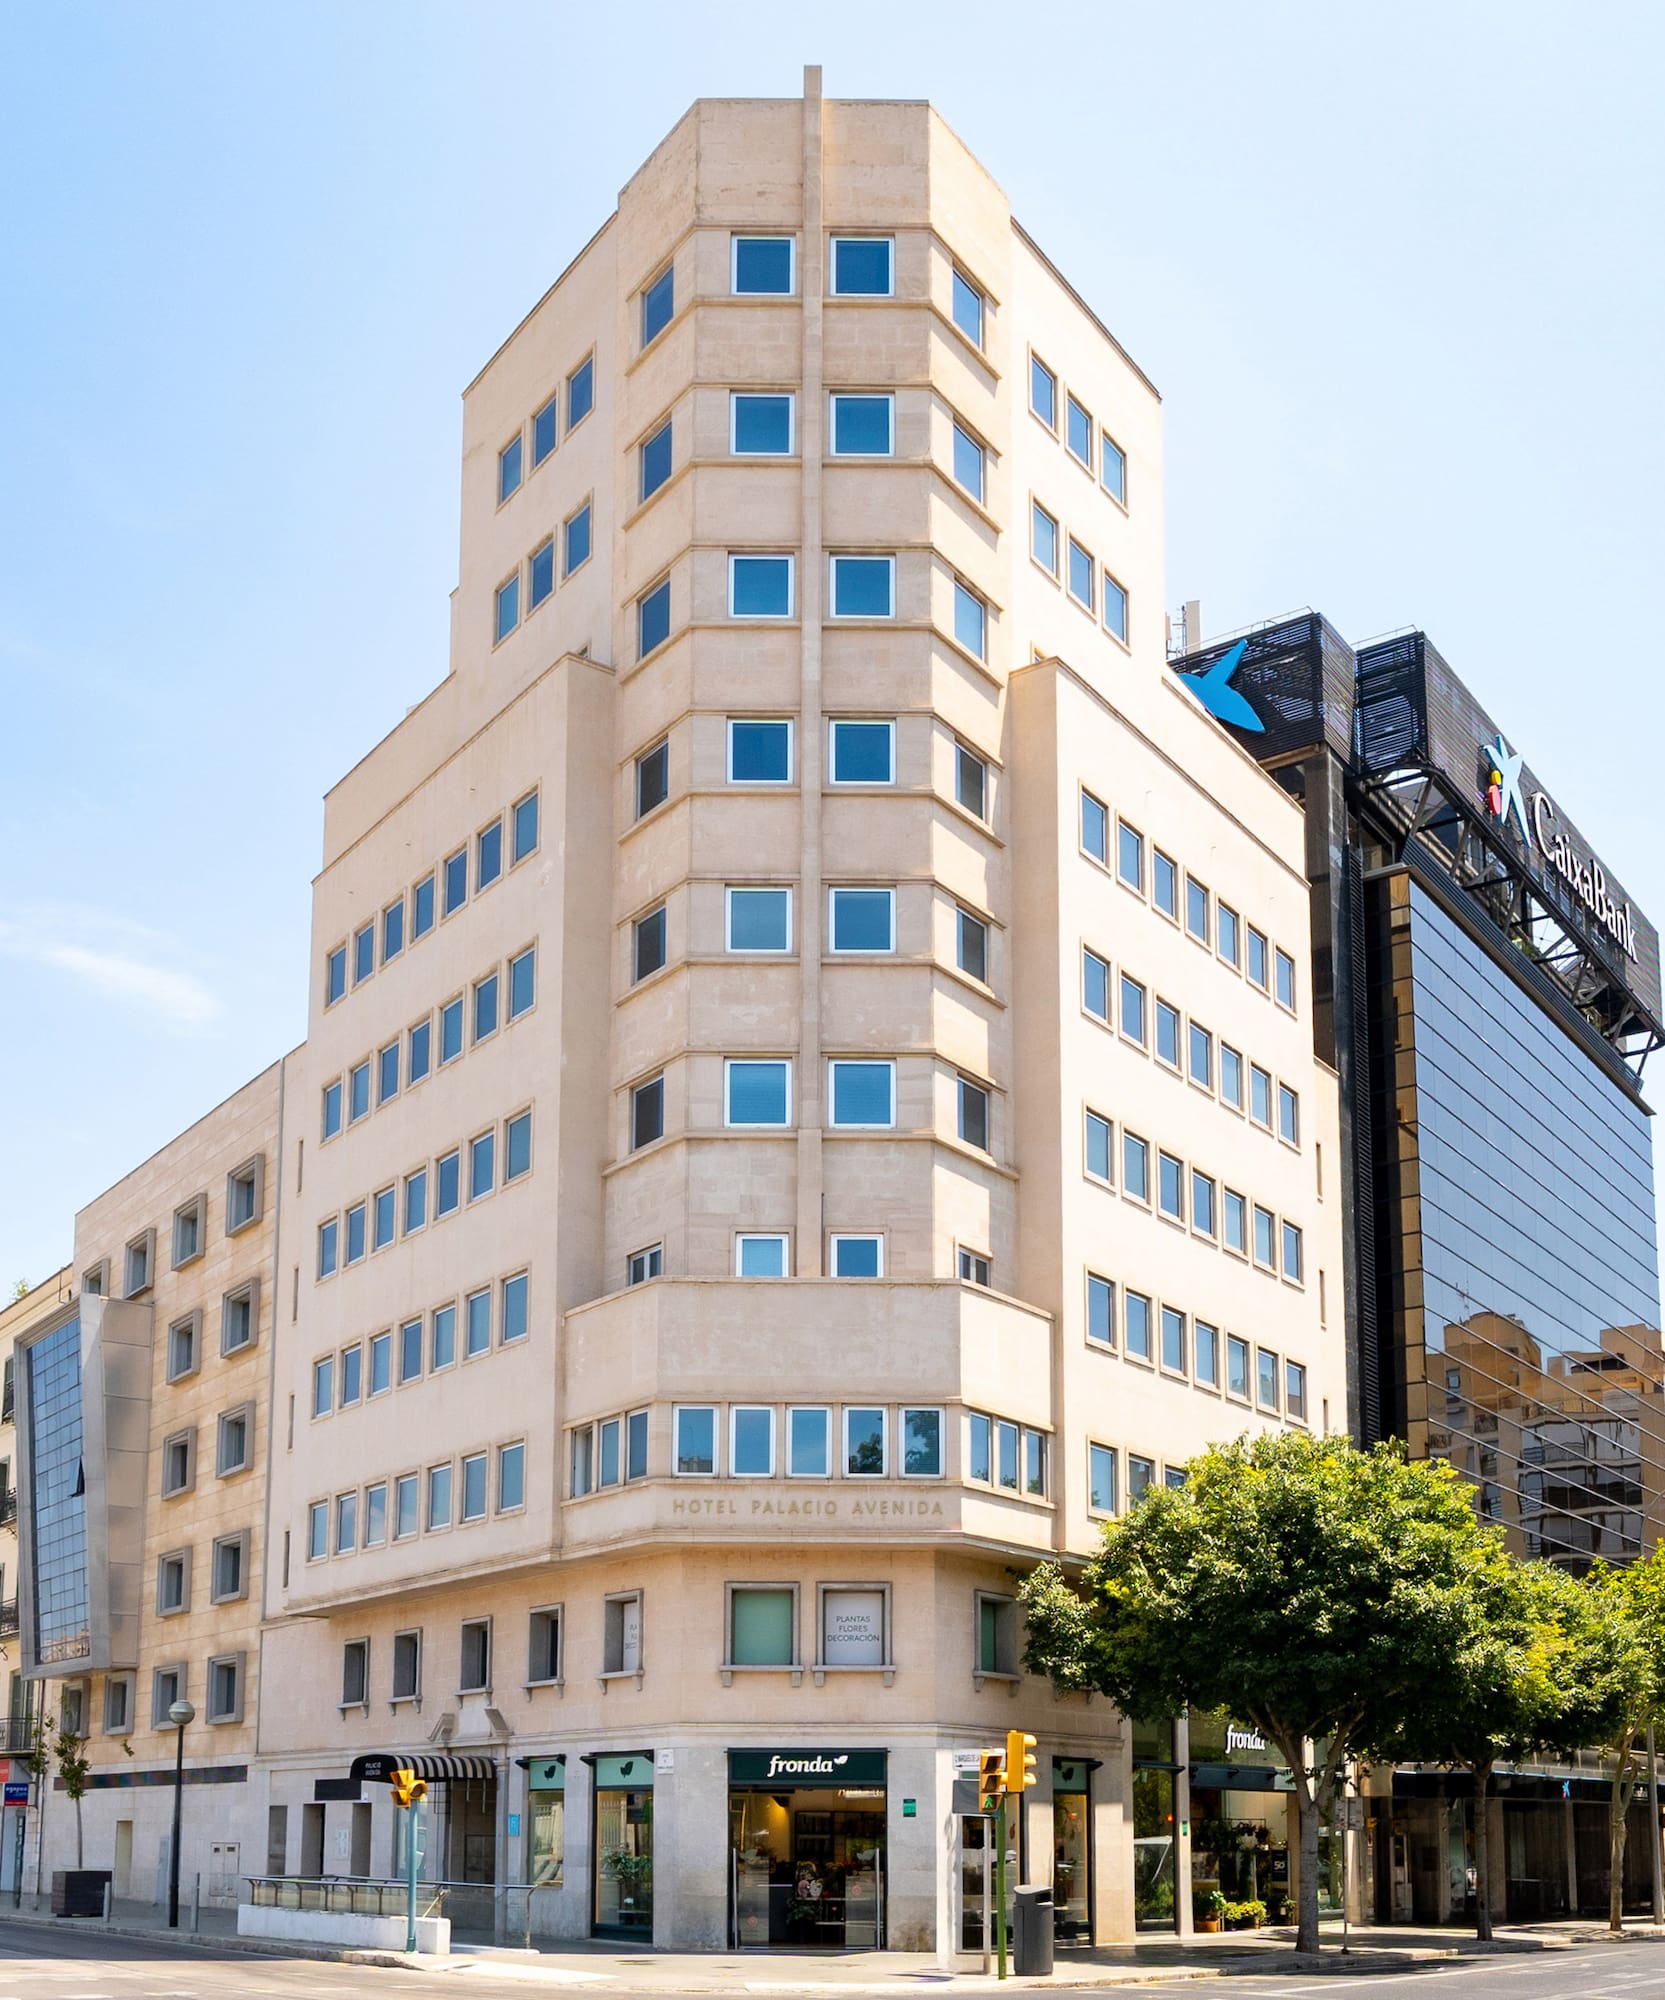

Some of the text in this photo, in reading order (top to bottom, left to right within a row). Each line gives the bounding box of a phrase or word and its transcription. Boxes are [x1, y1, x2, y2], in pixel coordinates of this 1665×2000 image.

[1531, 791, 1639, 965] CaixaBank
[672, 1499, 944, 1516] HOTEL PALACIO AVENIDA
[836, 1615, 871, 1623] PLANTAS
[839, 1624, 869, 1632] FLORES
[767, 1755, 834, 1778] fronda
